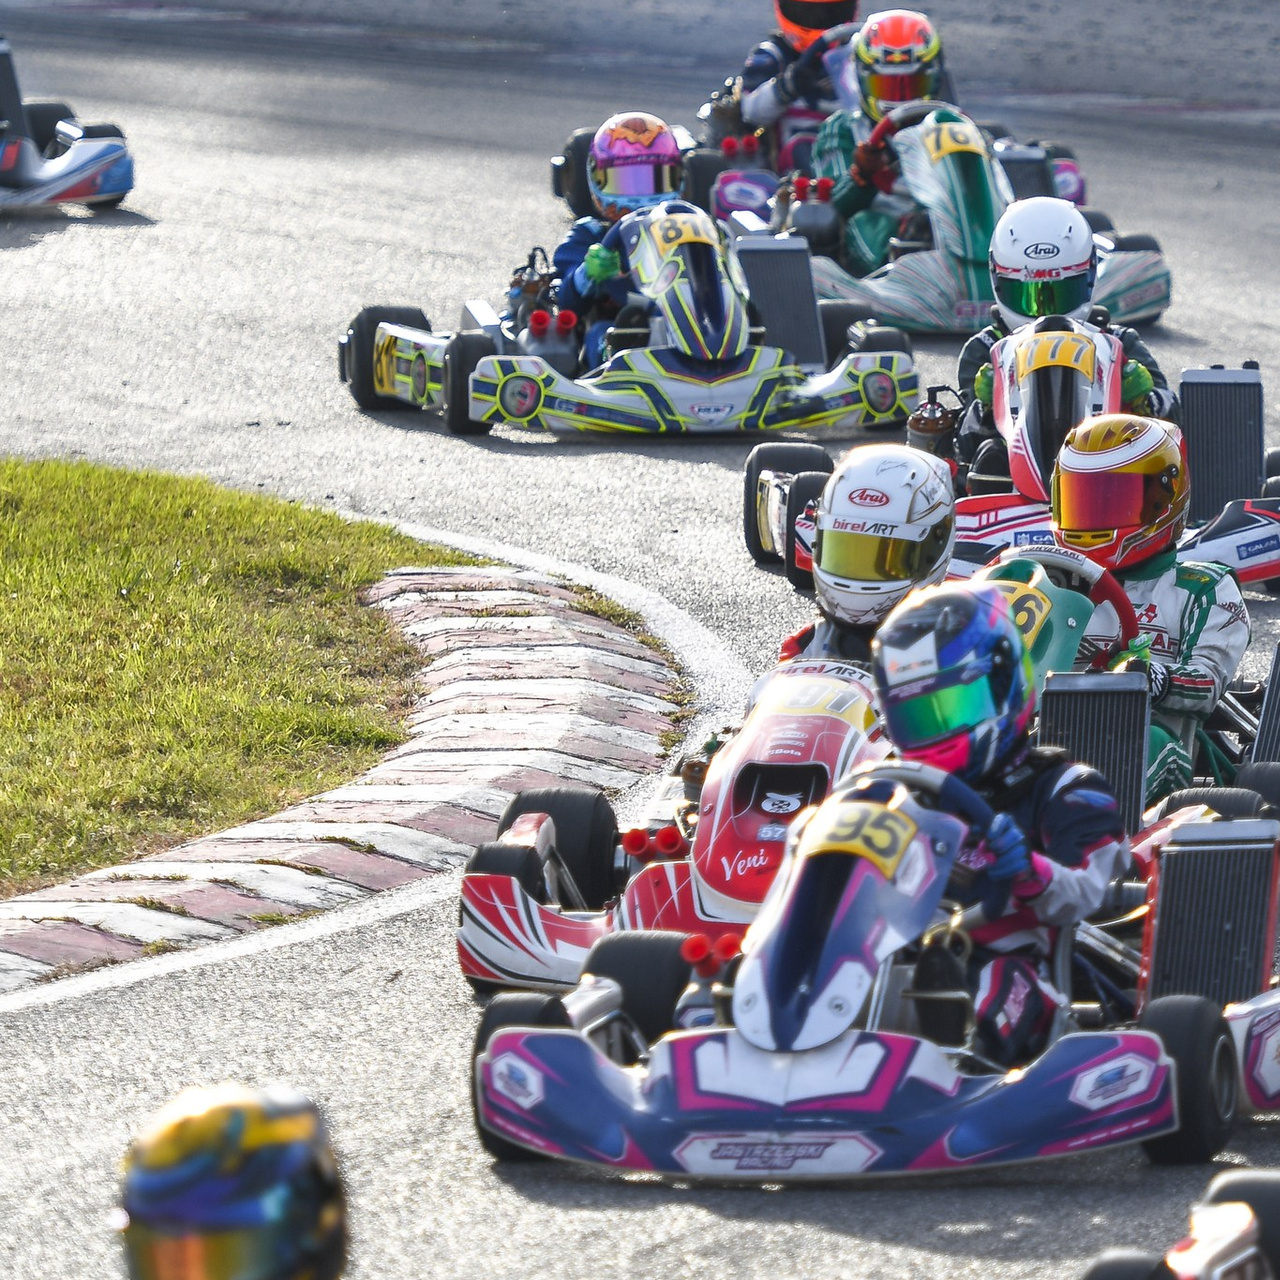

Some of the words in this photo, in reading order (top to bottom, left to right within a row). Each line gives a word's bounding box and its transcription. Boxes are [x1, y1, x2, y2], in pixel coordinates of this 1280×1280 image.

[1026, 335, 1089, 367] 777
[851, 489, 886, 504] Arai
[832, 518, 898, 536] birelART
